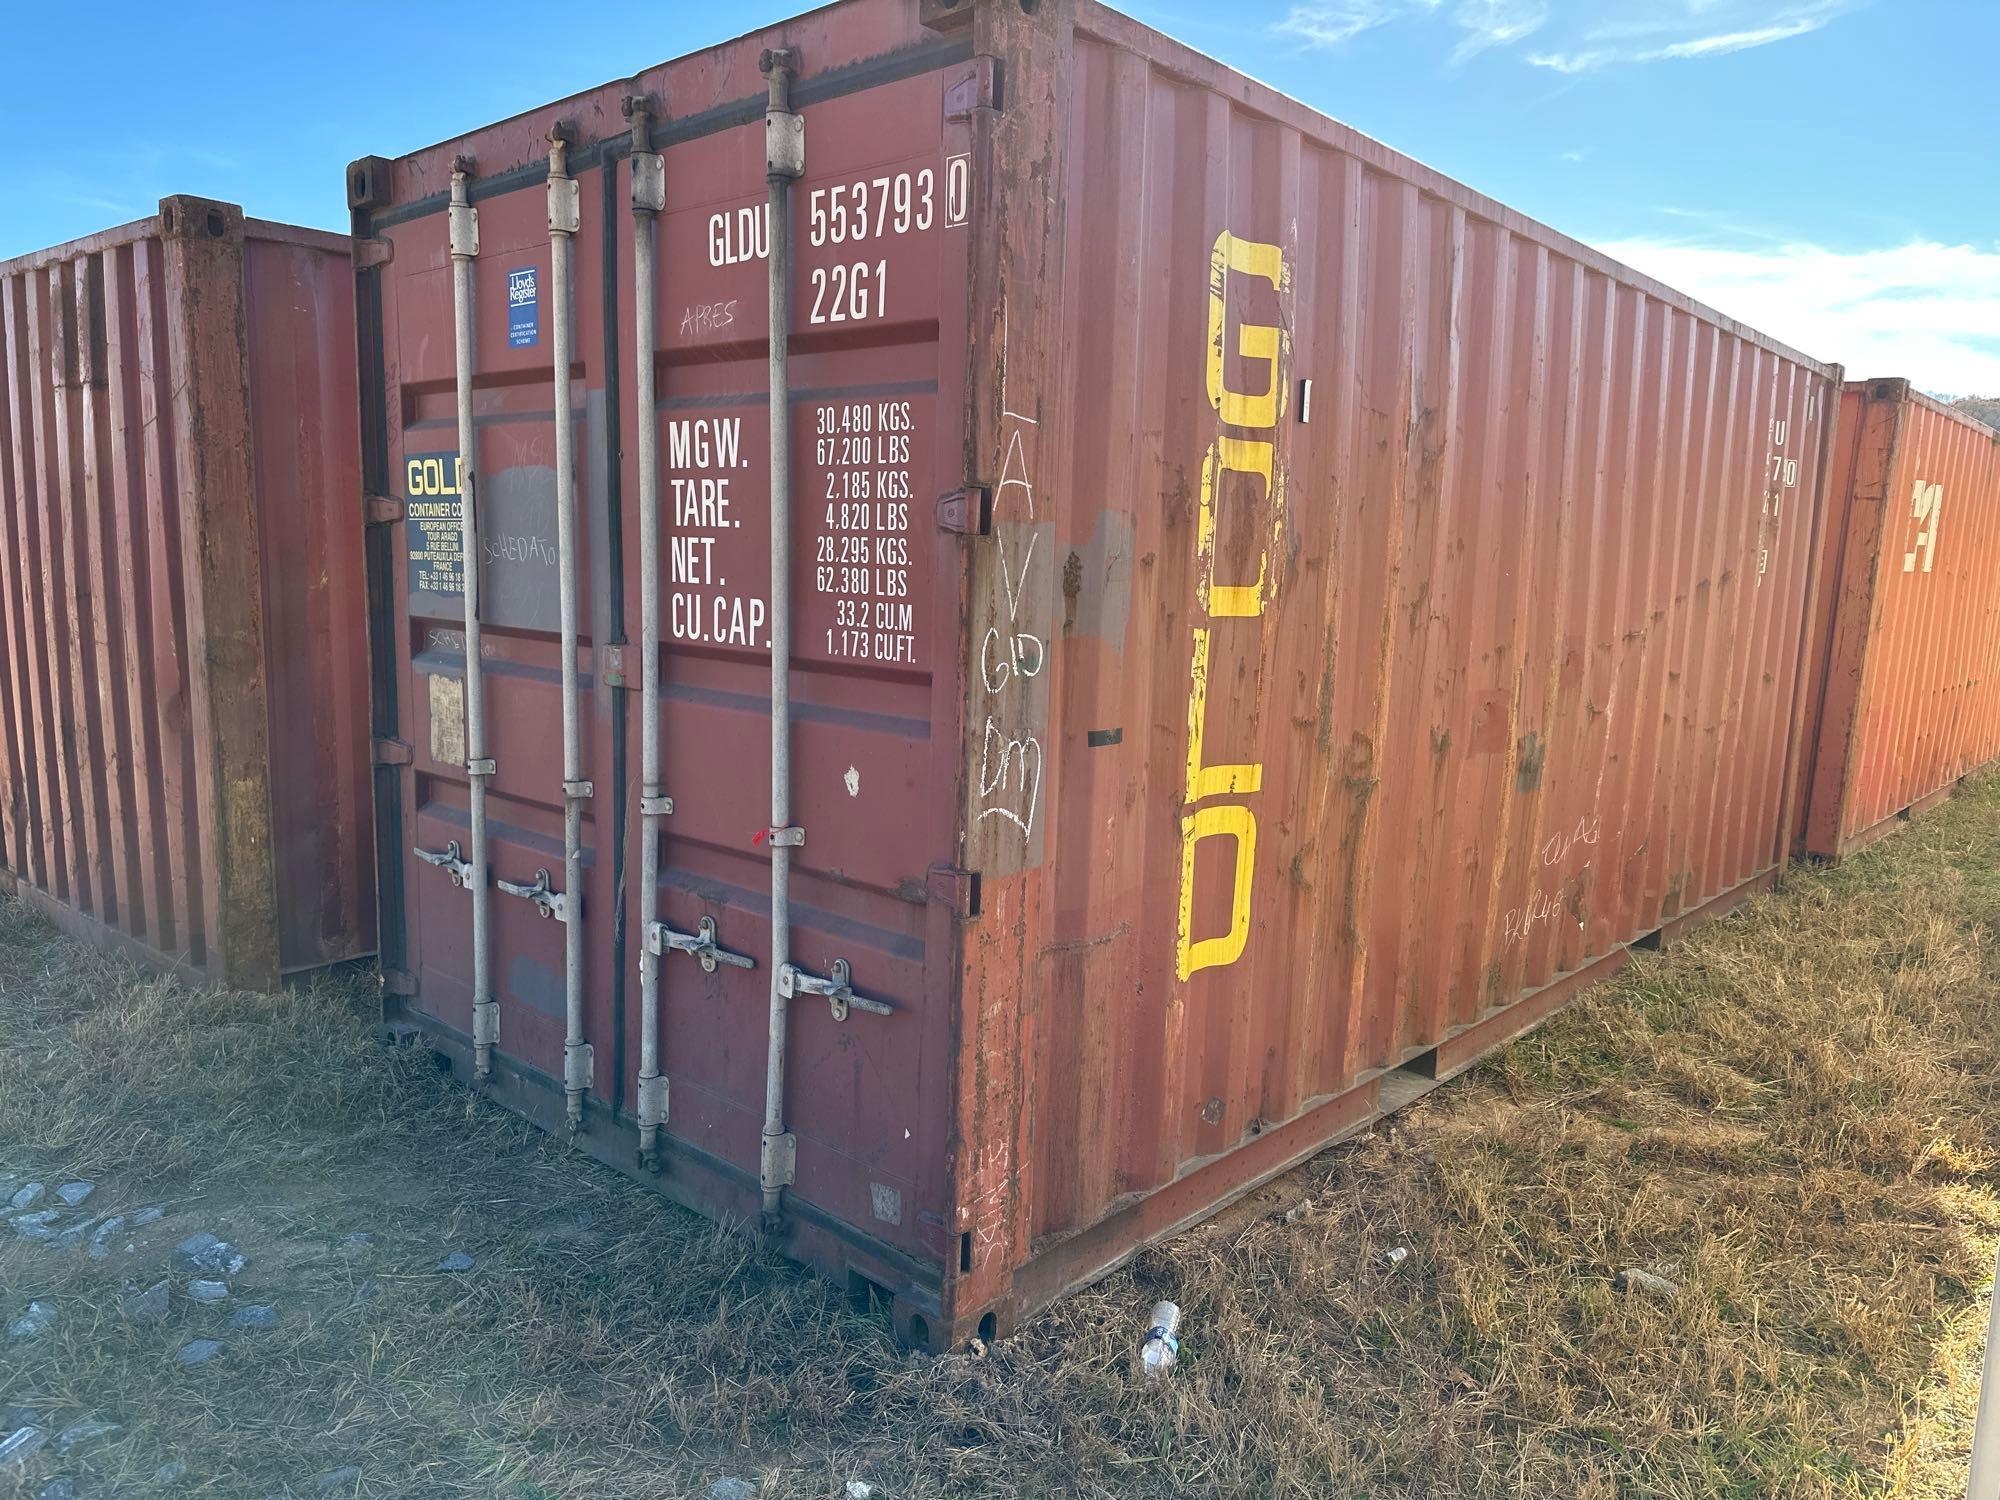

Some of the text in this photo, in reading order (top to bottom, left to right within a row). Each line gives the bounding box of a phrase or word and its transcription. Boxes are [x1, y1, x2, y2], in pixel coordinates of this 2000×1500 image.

[708, 158, 968, 267] GLDU 553793 0
[509, 286, 537, 303] Register
[810, 259, 887, 324] 22G1
[816, 402, 915, 434] 30,480 KGS.
[816, 435, 910, 465] 67,200 LBS
[826, 471, 914, 499] 2,185 KGS.
[408, 502, 451, 518] CONTAINER
[670, 478, 740, 528] TARE.
[825, 503, 908, 531] 4,820 LBS
[420, 521, 447, 531] EUROPEAN
[426, 531, 458, 541] TOUR ARAGO
[430, 541, 441, 551] RUE
[816, 536, 913, 566] 28,295 KGS.
[433, 561, 453, 572] FRANCE
[816, 566, 907, 597] 62,380 LBS
[671, 592, 772, 648] CU.CAP.
[837, 600, 913, 631] 33.2 CU.M
[826, 629, 870, 658] 1,173
